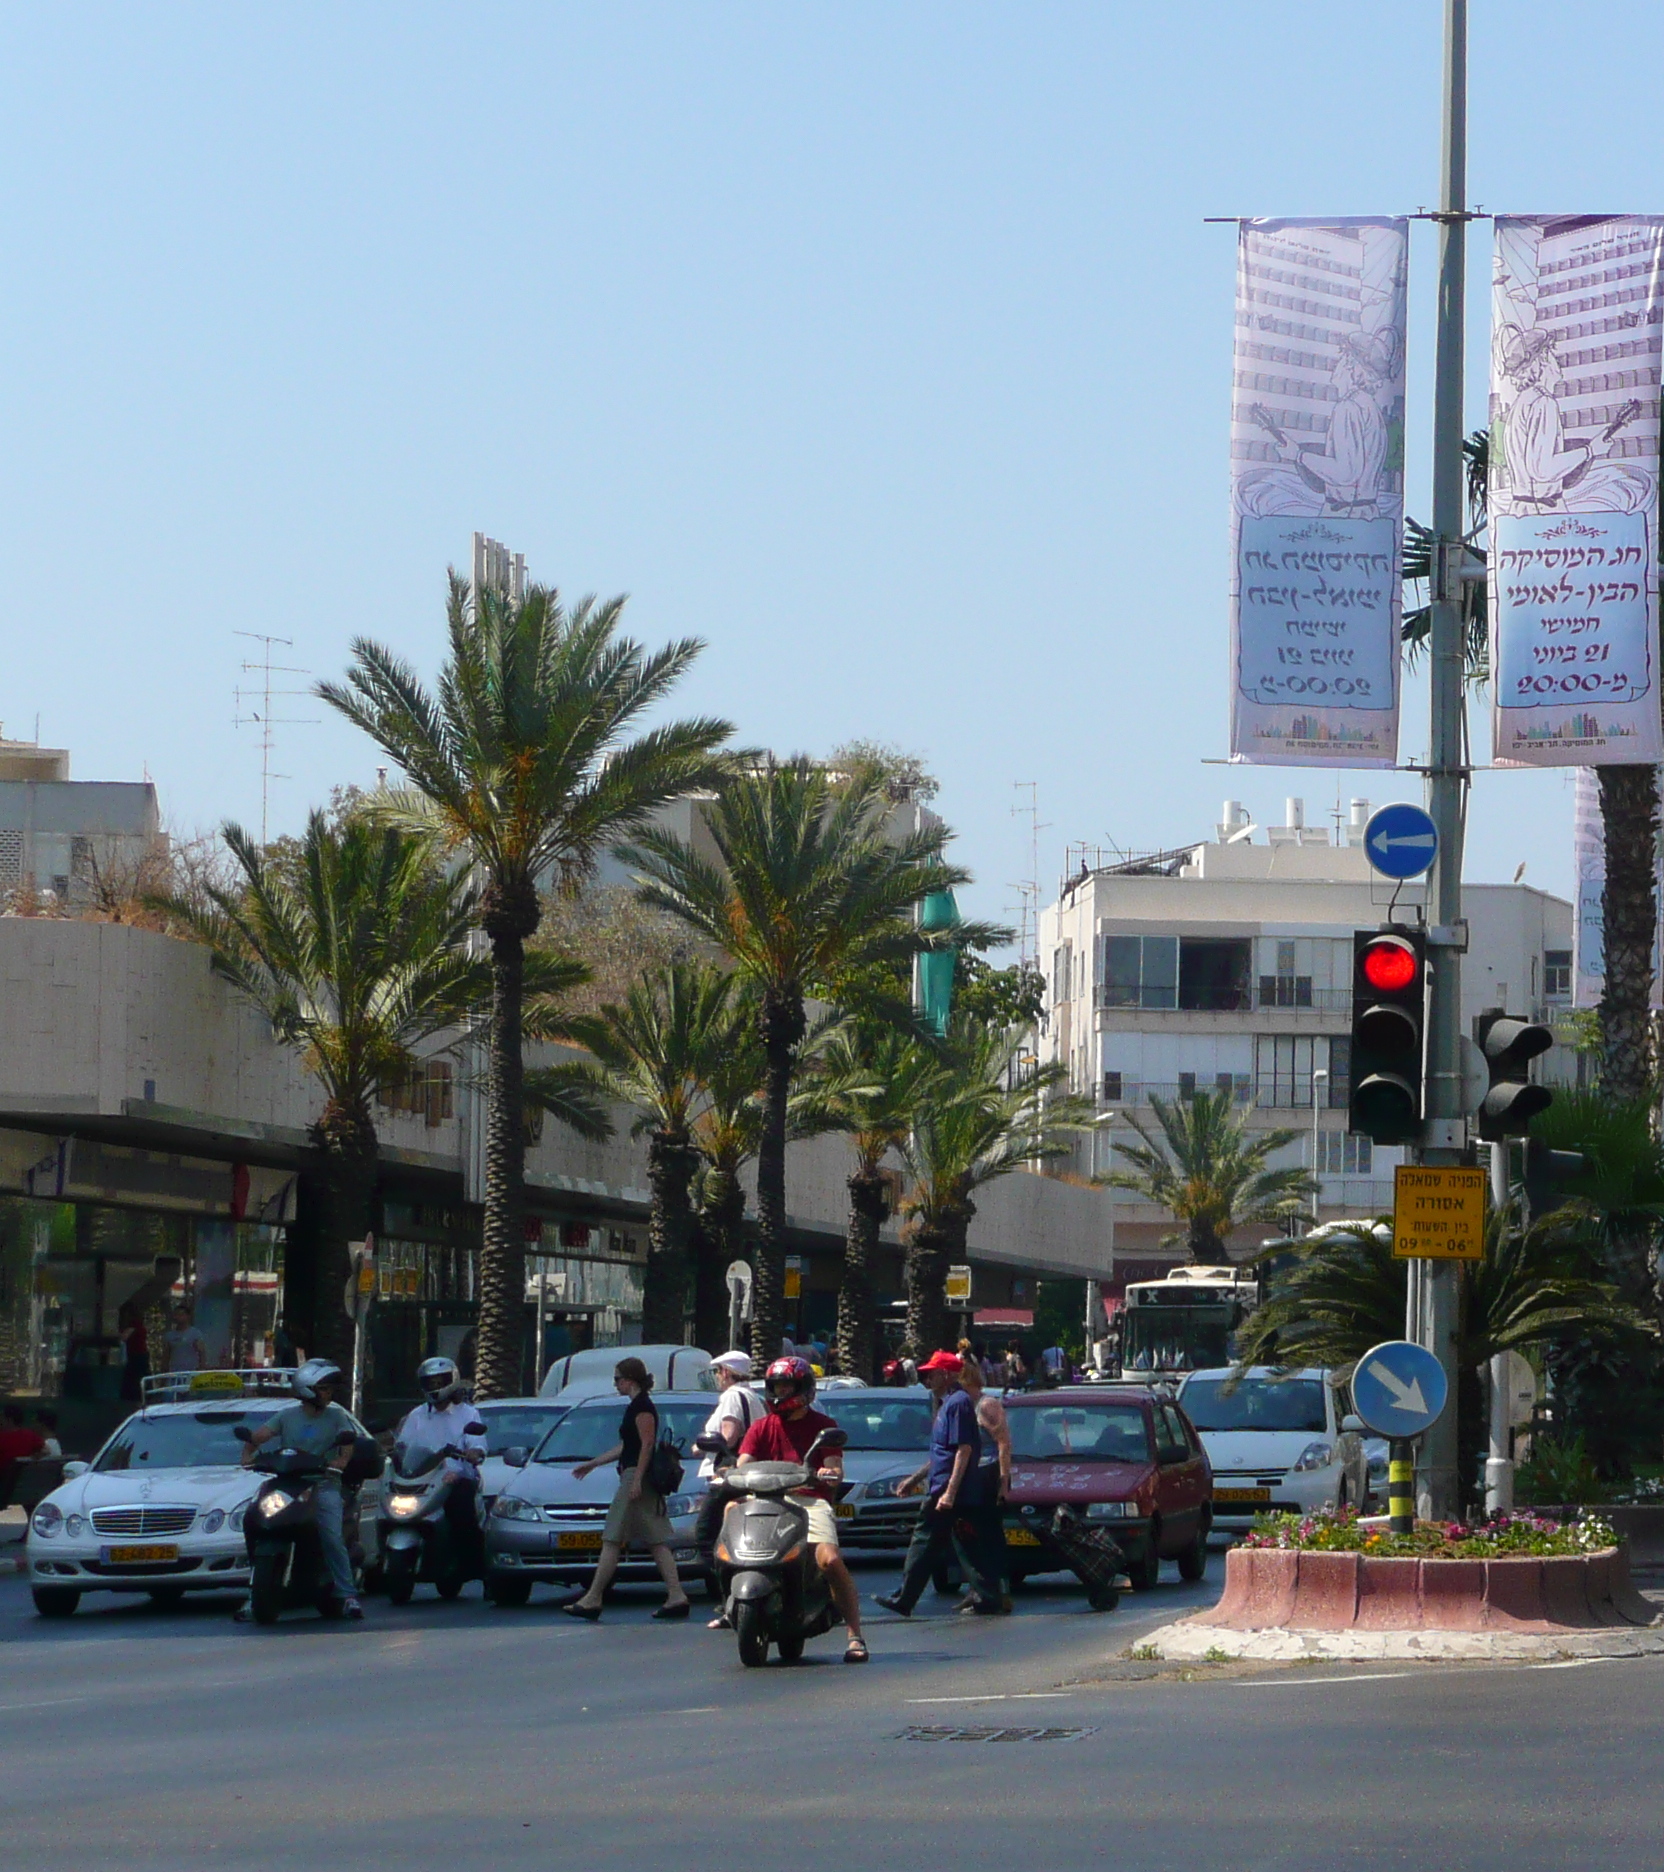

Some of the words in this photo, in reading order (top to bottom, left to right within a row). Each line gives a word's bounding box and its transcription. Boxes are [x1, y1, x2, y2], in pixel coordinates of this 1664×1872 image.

[1500, 548, 1605, 577] המוסיקה
[1608, 546, 1642, 566] חג
[1540, 617, 1601, 634] חמישי
[1533, 645, 1577, 664] ביוני
[1585, 643, 1610, 663] 21
[1415, 1197, 1464, 1210] אסורה
[1454, 1222, 1469, 1235] בין
